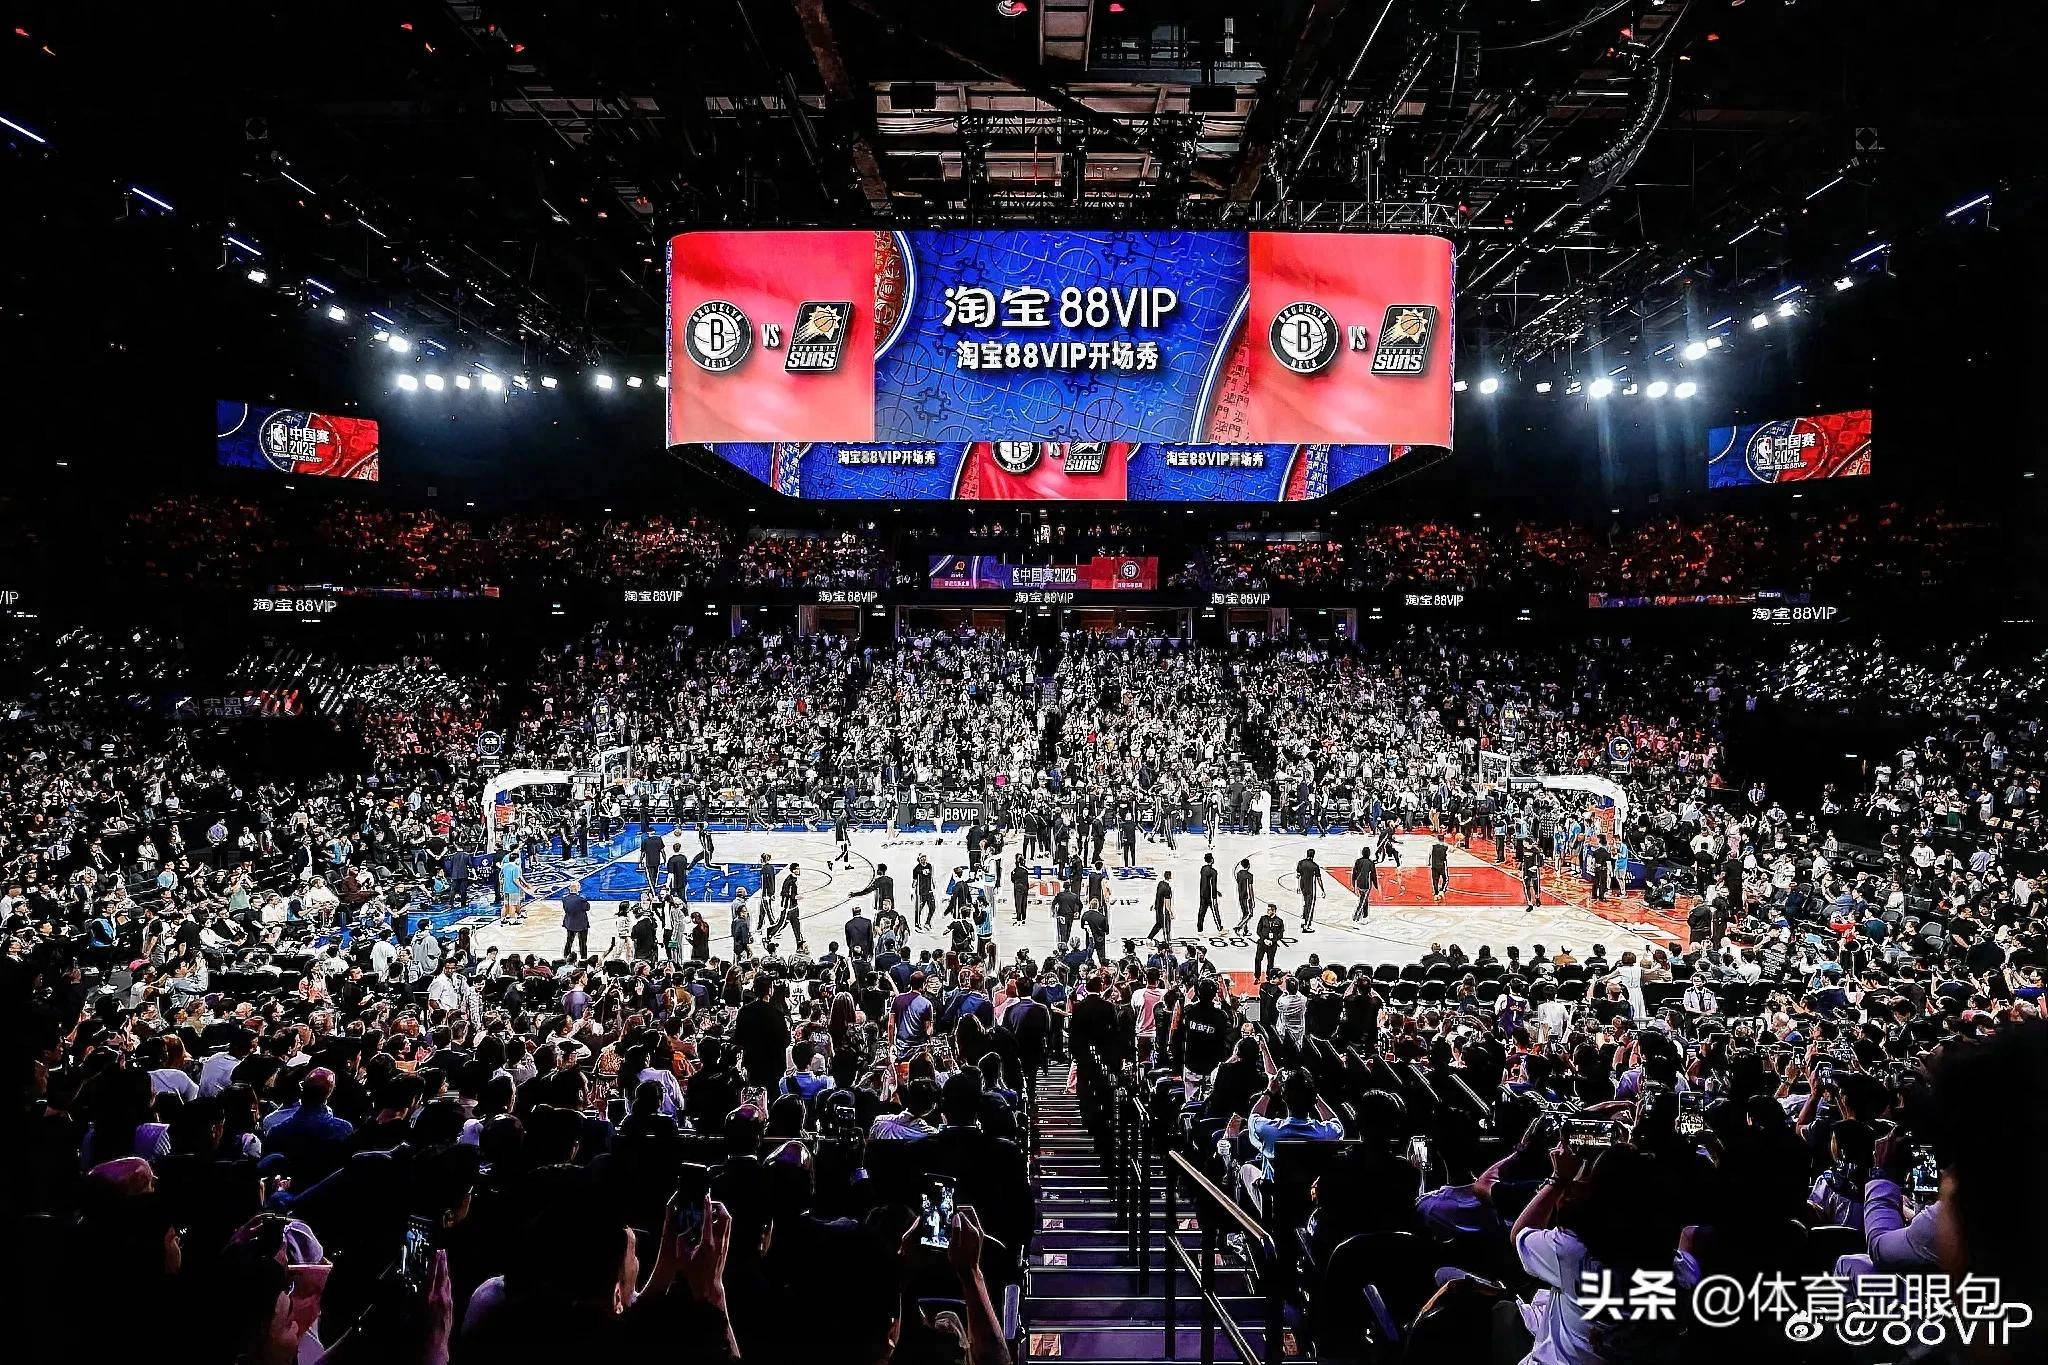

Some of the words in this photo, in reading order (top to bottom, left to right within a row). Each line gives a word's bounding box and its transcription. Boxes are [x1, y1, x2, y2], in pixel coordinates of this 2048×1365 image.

[942, 285, 1050, 328] 淘宝
[1059, 286, 1177, 328] 88VIP
[711, 318, 725, 352] B
[761, 323, 780, 347] VS
[1297, 320, 1311, 353] B
[1347, 325, 1367, 349] VS
[956, 341, 1159, 370] 淘宝88VIP开场秀
[290, 427, 330, 444] 中国赛
[1774, 433, 1816, 449] 中国赛
[289, 440, 316, 456] 2025
[1774, 448, 1800, 465] 2025
[837, 449, 936, 465] 淘宝88VIP开场秀
[1166, 451, 1264, 466] 淘宝88VIP开场秀
[295, 599, 337, 613] 88VIP
[1792, 607, 1837, 620] 88VIP
